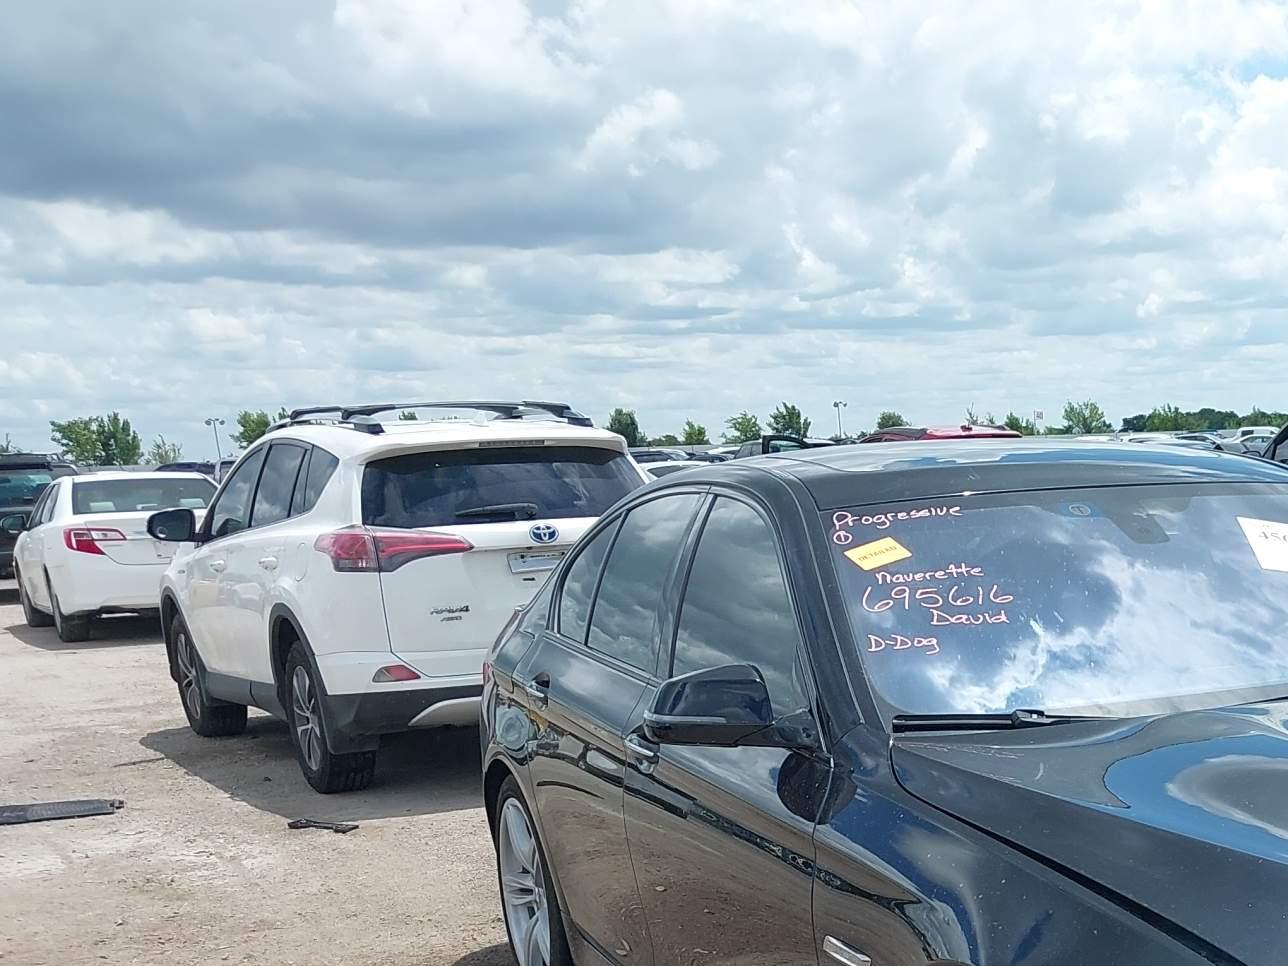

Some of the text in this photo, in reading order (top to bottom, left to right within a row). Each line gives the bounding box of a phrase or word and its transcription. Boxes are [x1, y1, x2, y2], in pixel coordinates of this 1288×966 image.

[832, 506, 963, 530] Progressive
[862, 584, 1014, 612] 695616
[929, 608, 1010, 625] David
